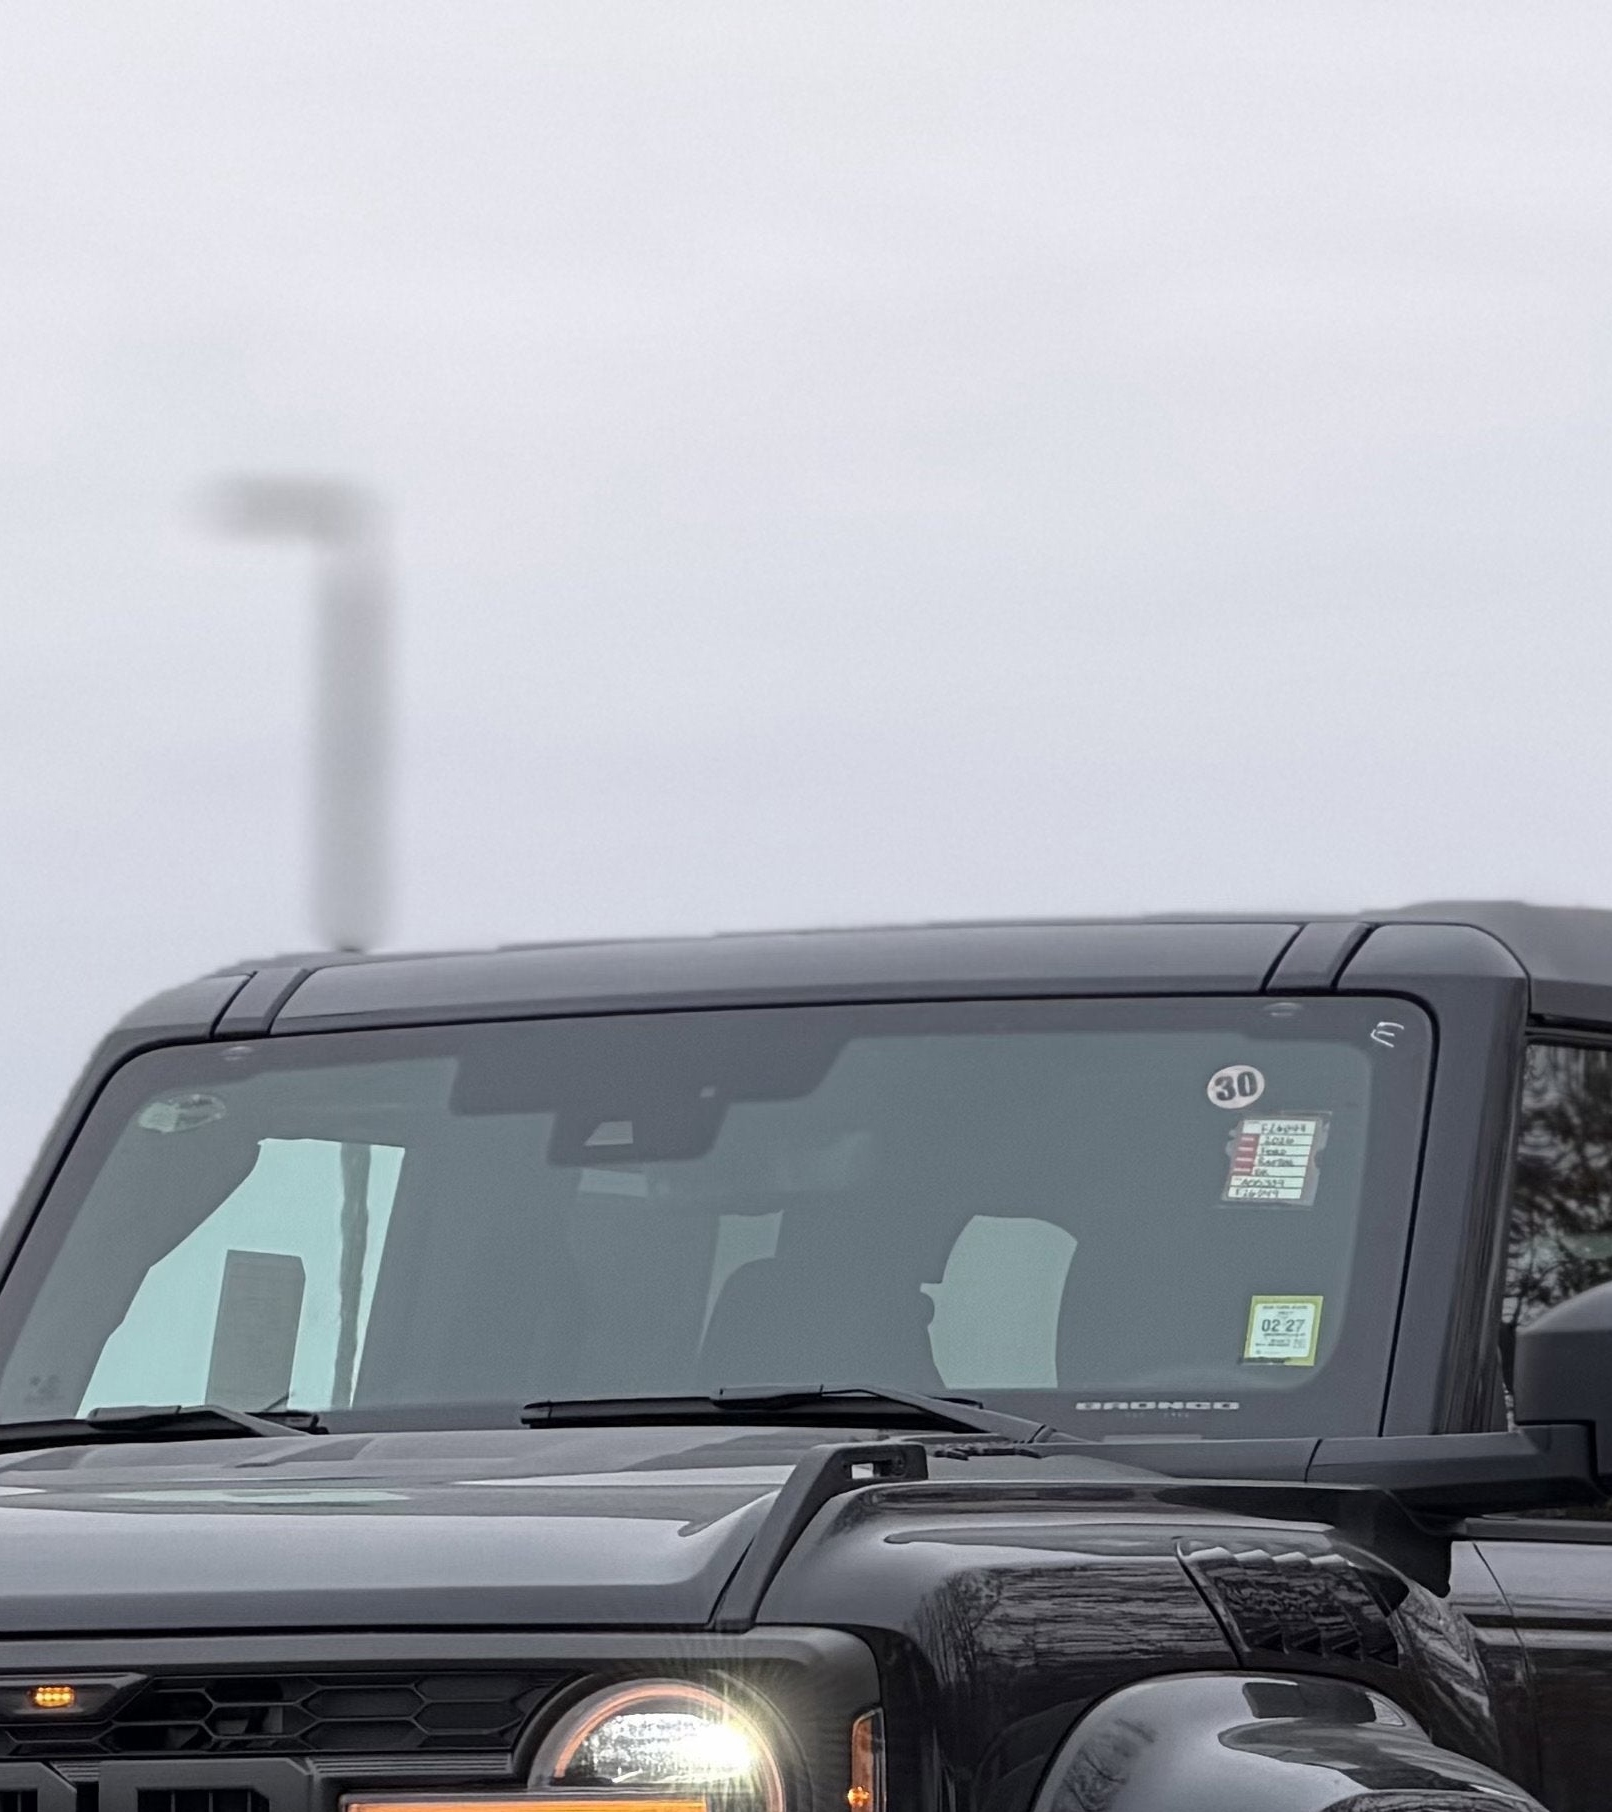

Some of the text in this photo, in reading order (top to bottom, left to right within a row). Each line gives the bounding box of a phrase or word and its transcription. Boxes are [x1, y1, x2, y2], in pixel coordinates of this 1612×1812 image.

[1214, 1071, 1258, 1101] 30
[1261, 1318, 1307, 1333] 02 27
